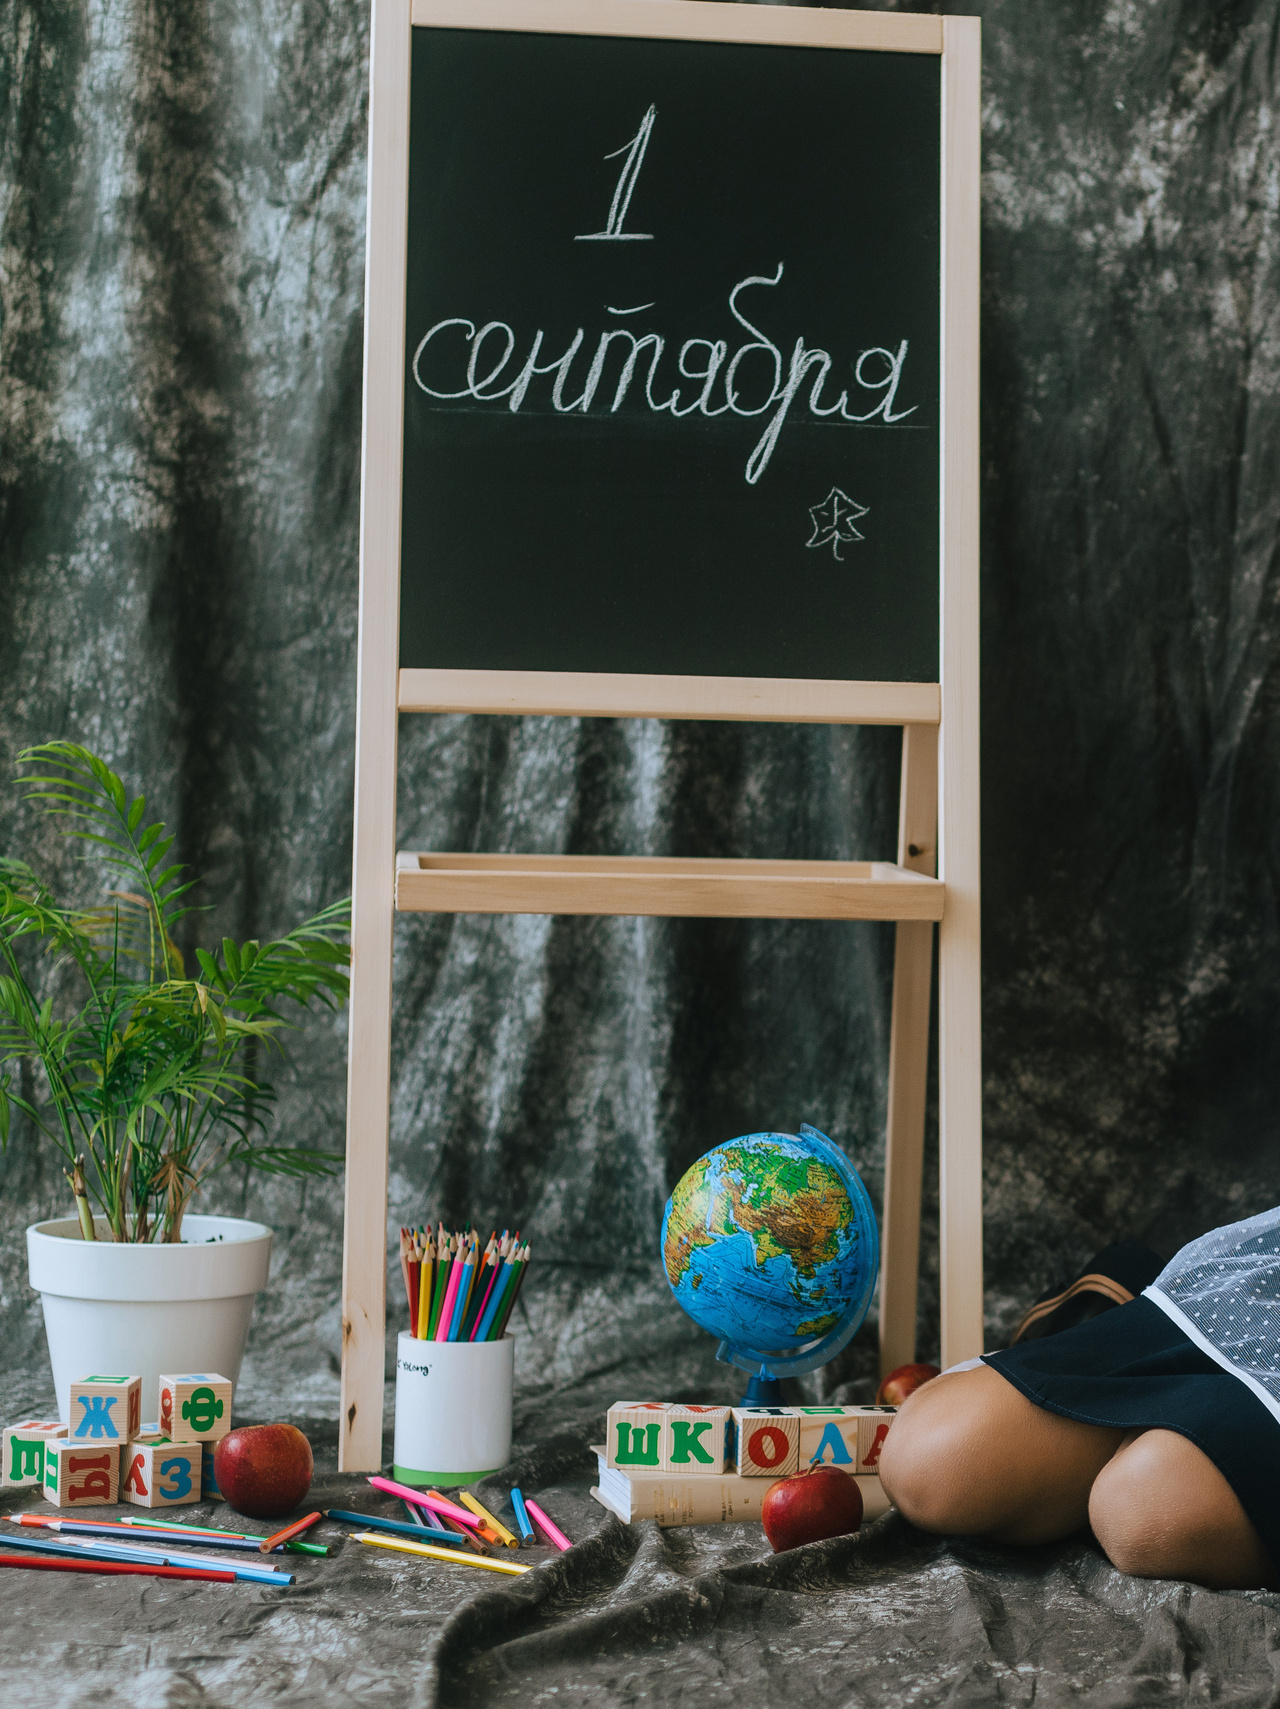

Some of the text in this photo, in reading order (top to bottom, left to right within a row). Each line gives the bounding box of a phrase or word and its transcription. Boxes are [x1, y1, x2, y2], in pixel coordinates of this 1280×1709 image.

[574, 103, 656, 241] 1
[412, 261, 919, 485] сентября
[74, 1396, 119, 1438] Ж
